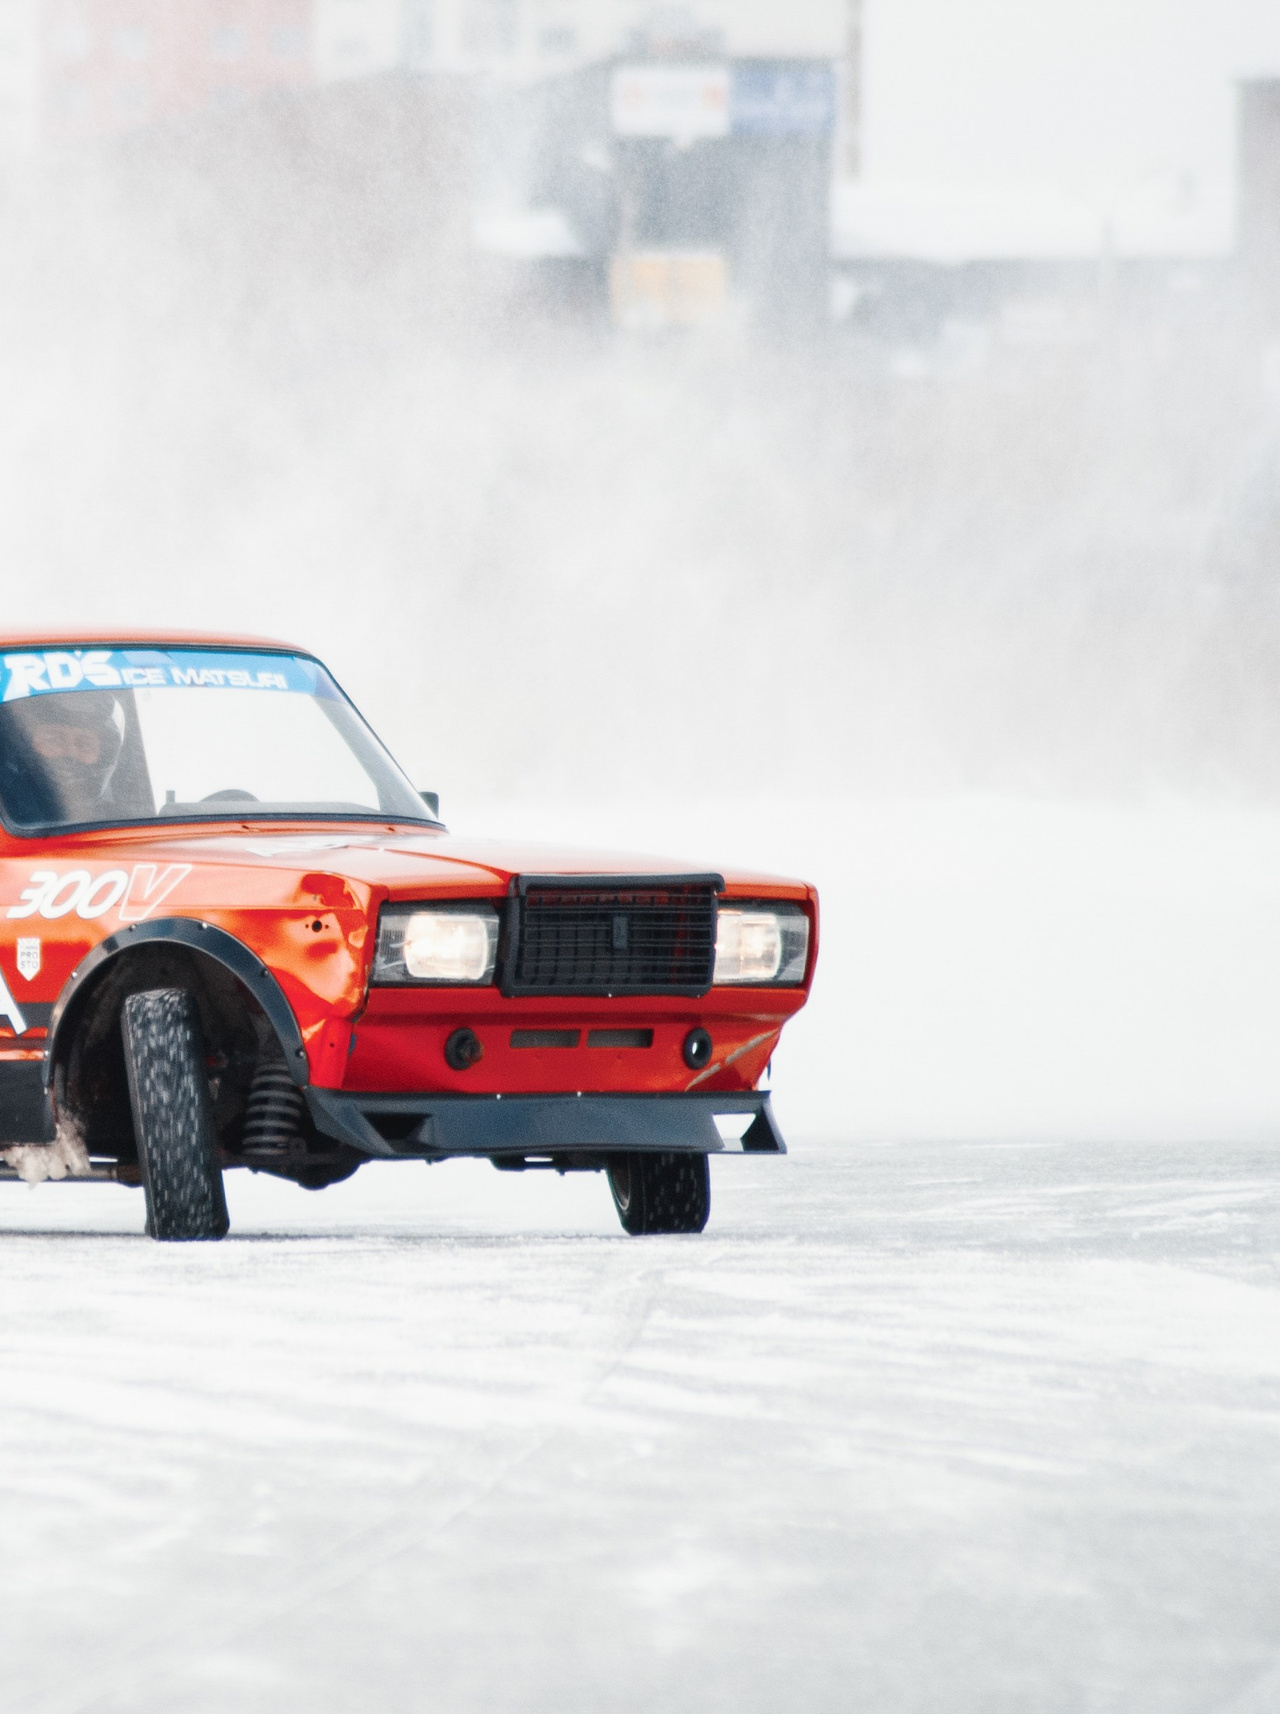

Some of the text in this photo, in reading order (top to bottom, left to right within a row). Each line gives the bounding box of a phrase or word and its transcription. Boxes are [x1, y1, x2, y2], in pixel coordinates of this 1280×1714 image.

[123, 668, 165, 685] ICE
[173, 668, 288, 689] MATSURI
[5, 863, 193, 921] 300V
